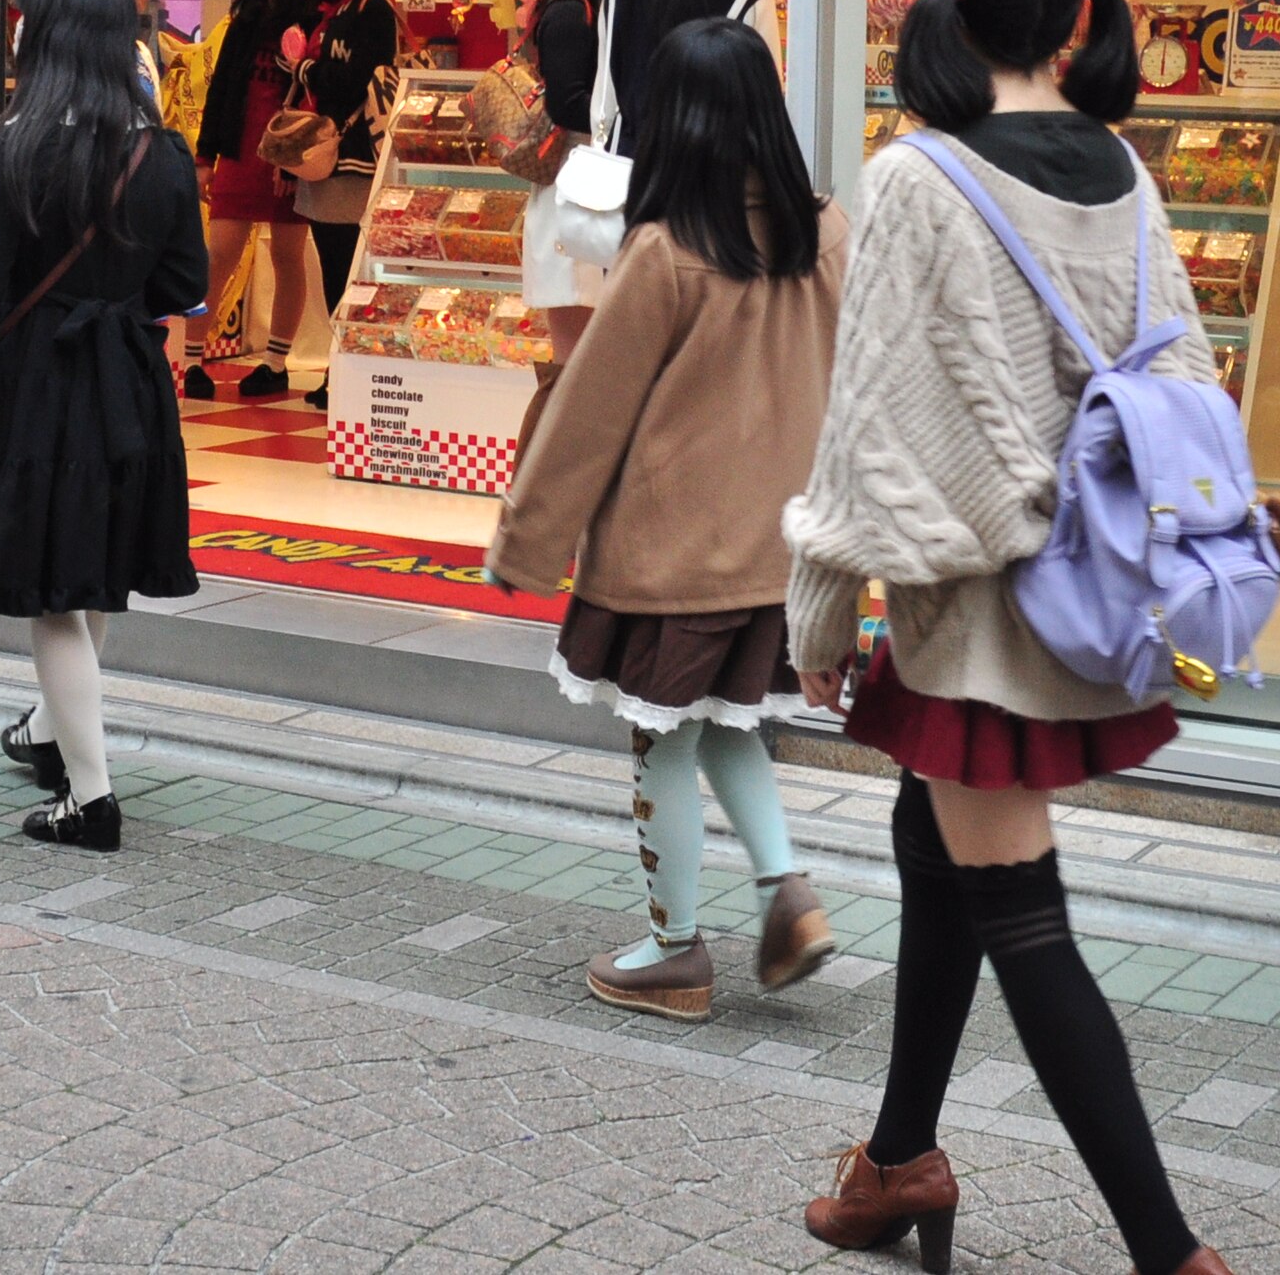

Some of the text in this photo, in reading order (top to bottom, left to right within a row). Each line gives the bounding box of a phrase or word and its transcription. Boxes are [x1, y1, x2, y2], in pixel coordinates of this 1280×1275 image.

[371, 374, 403, 386] candy
[371, 388, 424, 403] chocolate
[371, 404, 409, 417] gummy
[370, 416, 407, 431] biscuit
[370, 432, 423, 447] lemonade
[370, 447, 440, 464] chewing gum
[369, 463, 448, 480] marshmallows
